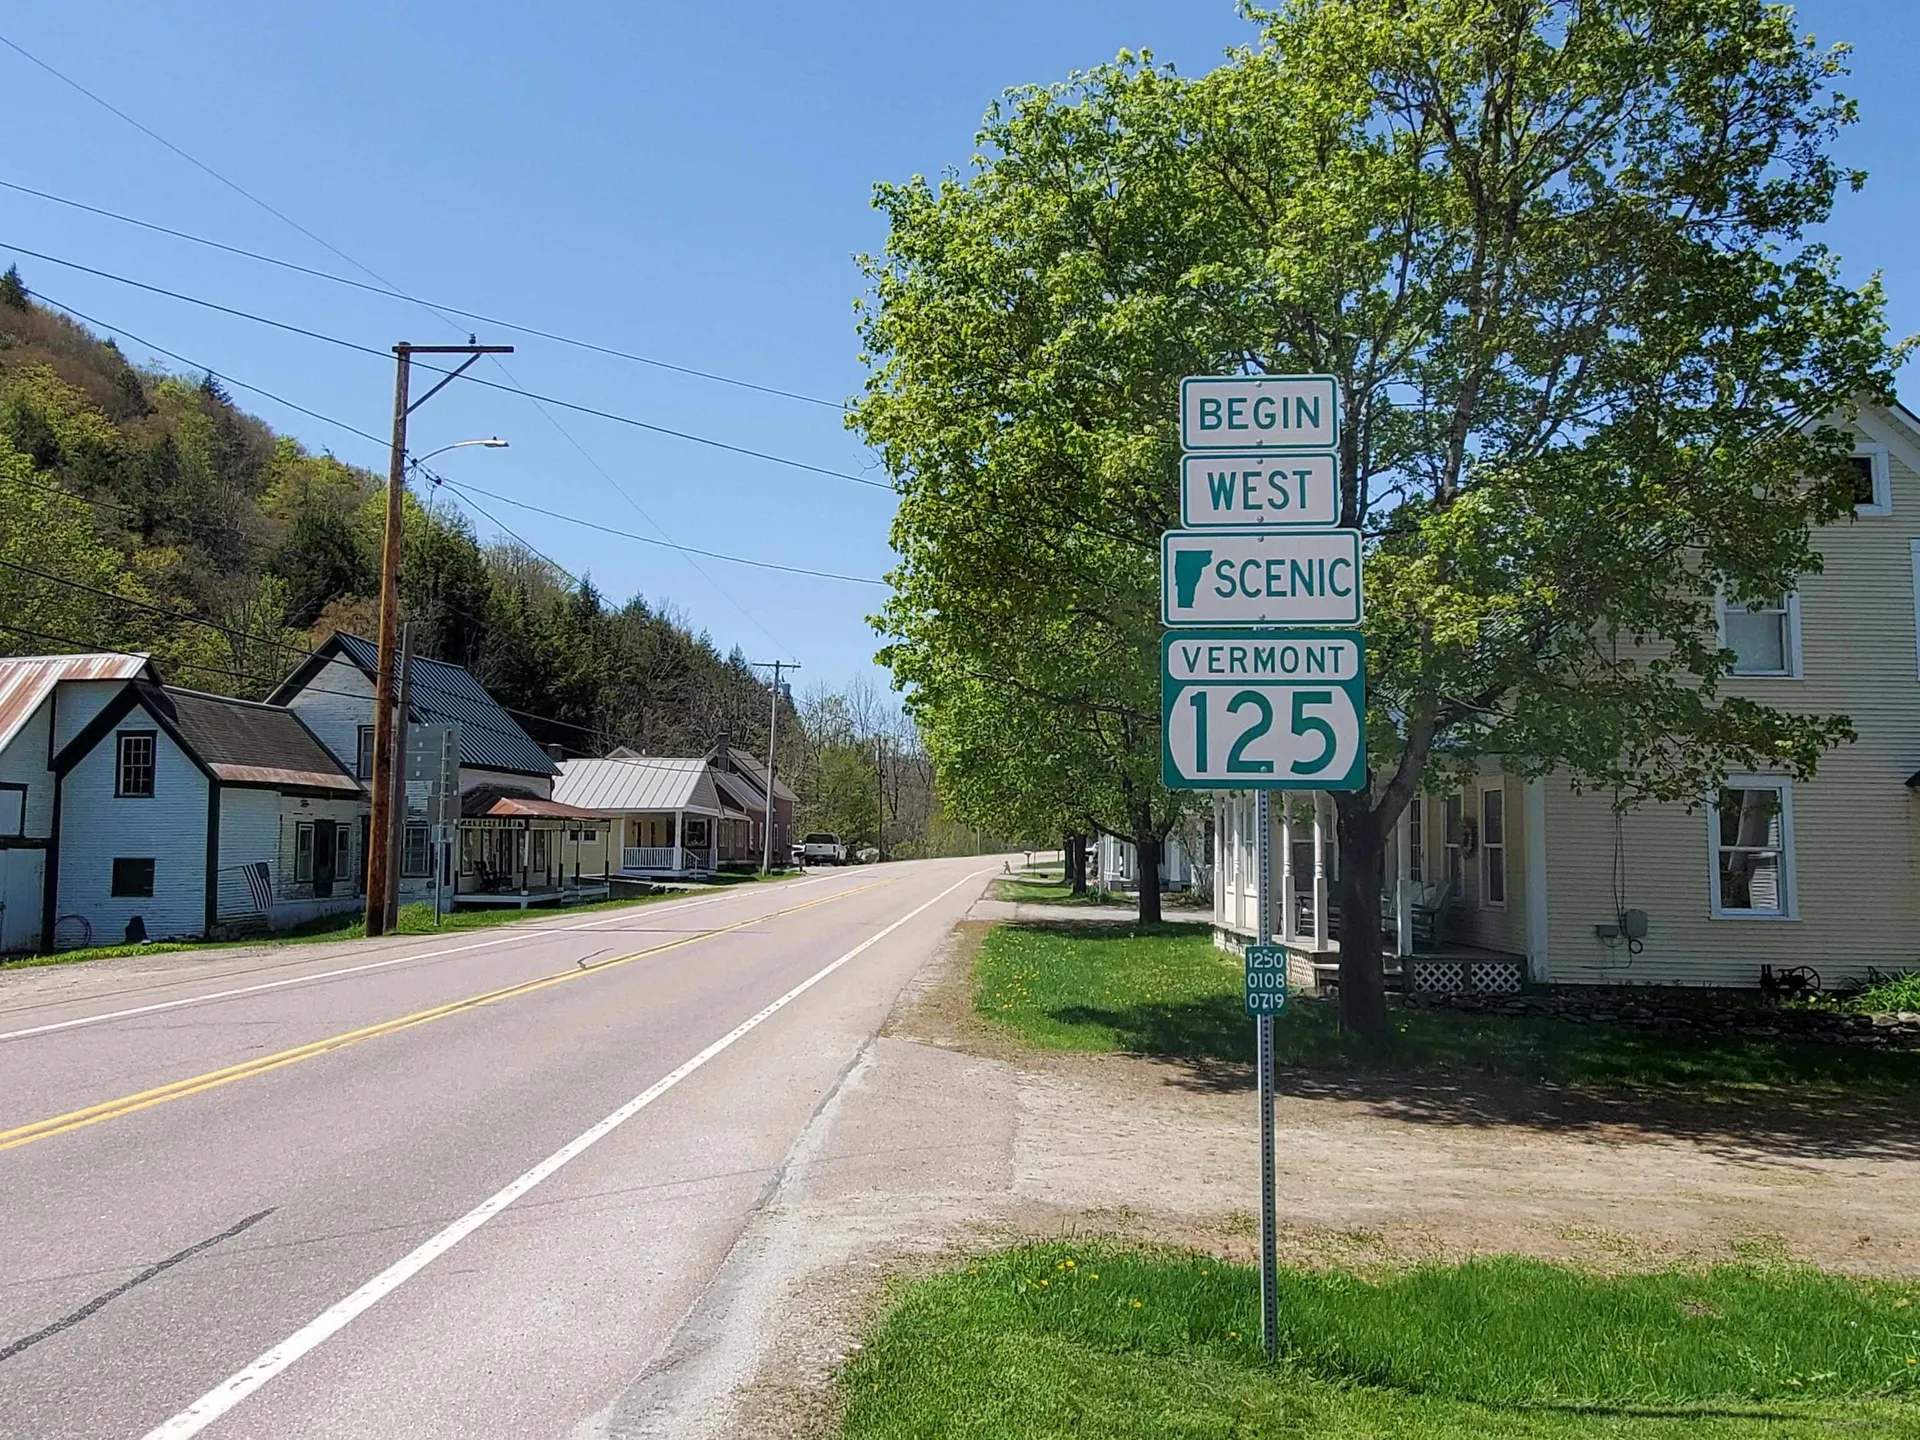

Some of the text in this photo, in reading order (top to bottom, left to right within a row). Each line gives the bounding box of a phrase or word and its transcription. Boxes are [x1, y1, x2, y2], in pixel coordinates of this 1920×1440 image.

[1200, 396, 1320, 430] BEGIN
[1207, 470, 1313, 511] WEST
[1214, 558, 1352, 598] SCENIC
[1181, 646, 1345, 674] VERMONT
[1190, 690, 1338, 775] 125
[1248, 952, 1284, 968] 1250
[1247, 972, 1285, 988] 0108
[1248, 993, 1285, 1009] 0719
